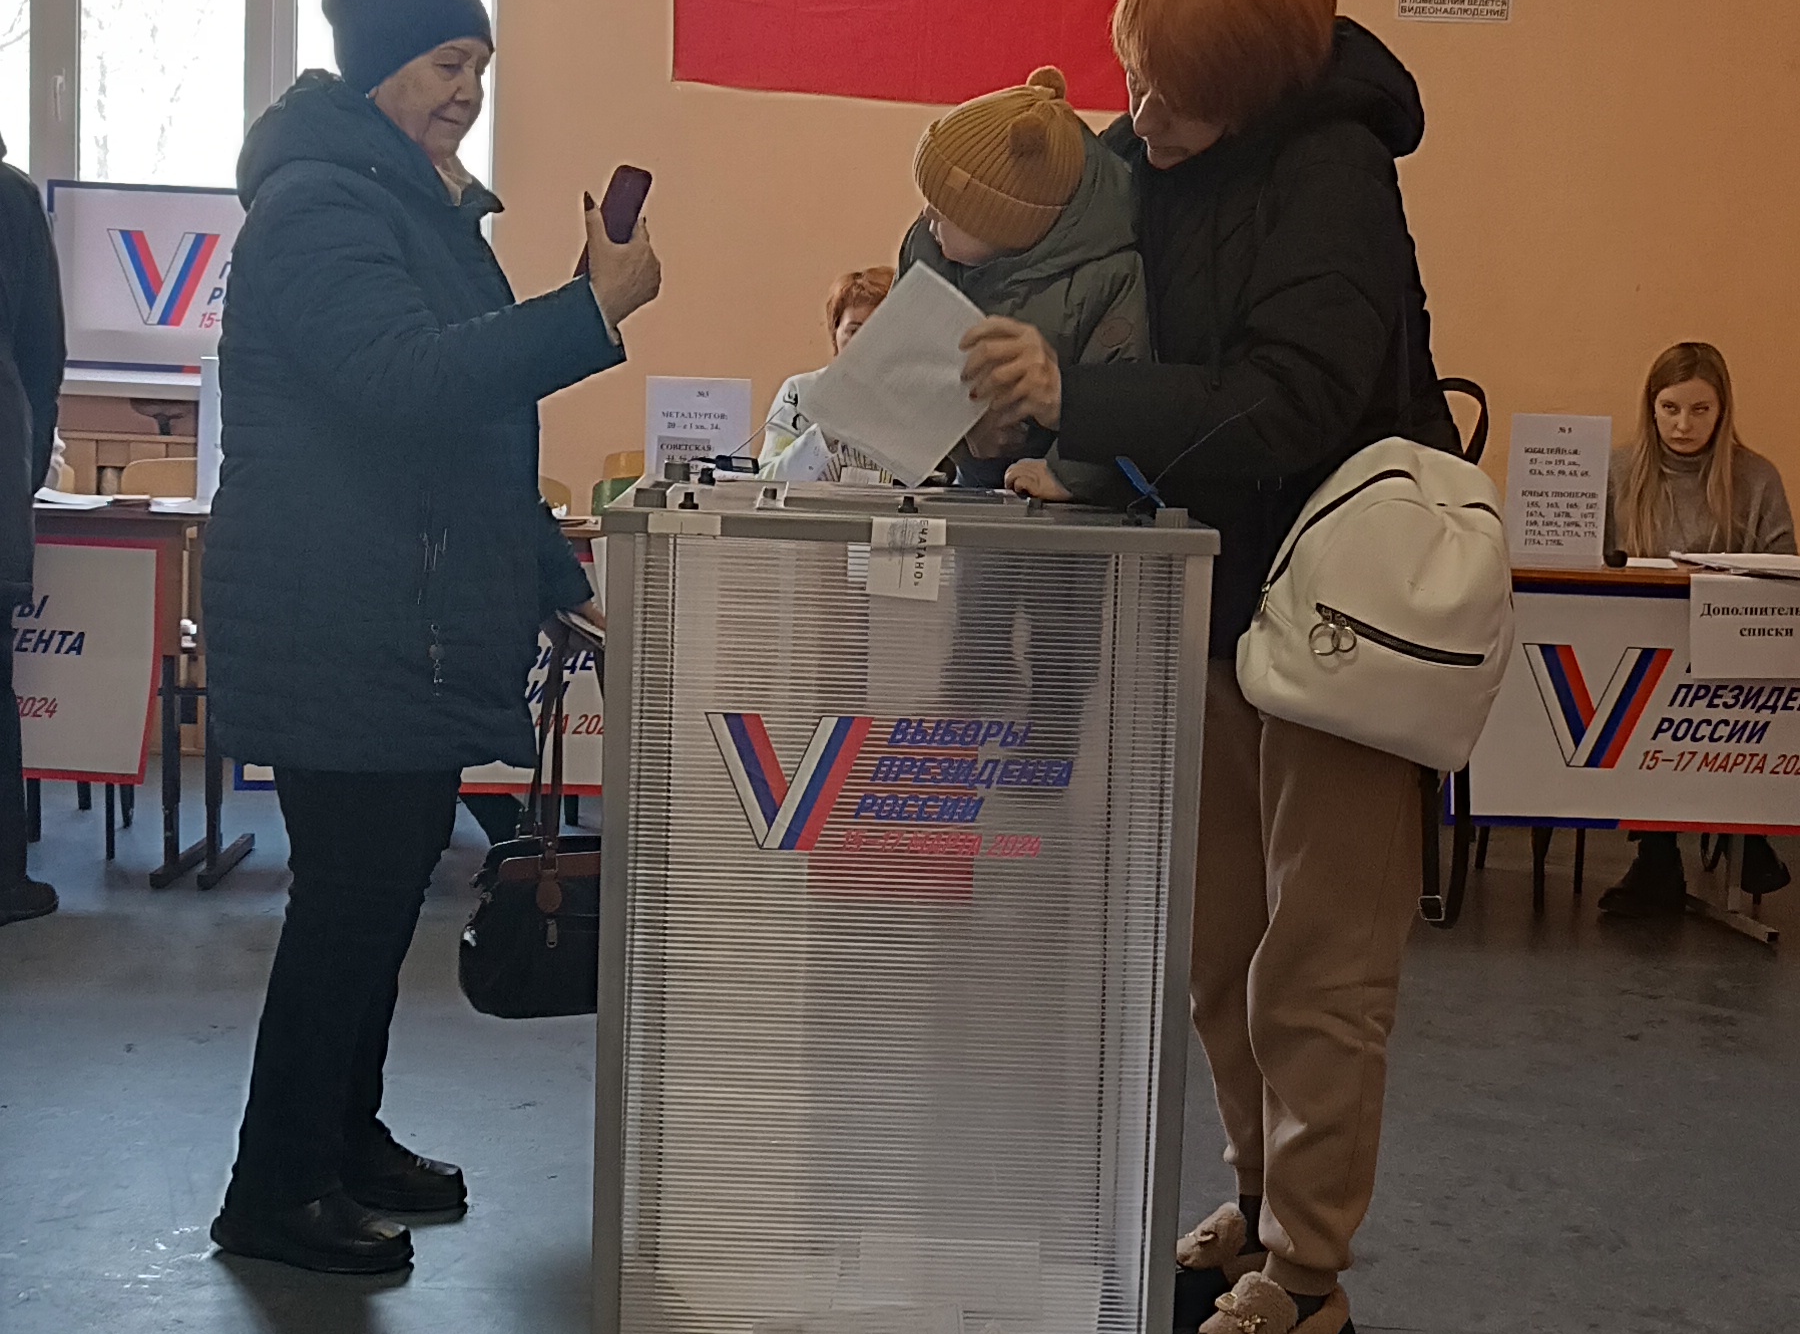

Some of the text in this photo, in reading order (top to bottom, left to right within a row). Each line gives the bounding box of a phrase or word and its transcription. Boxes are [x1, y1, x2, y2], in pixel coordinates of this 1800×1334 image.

[1400, 5, 1506, 17] ВИДЕОНАБЛЮДЕНИЕ
[13, 628, 85, 656] ЕНТА
[1739, 626, 1794, 637] списки
[1667, 683, 1800, 715] ПРЕЗИДЕ
[888, 718, 1034, 747] ВЫБОРЫ
[1651, 717, 1771, 744] РОССИИ
[869, 755, 1074, 789] ПРЕЗИДЕНТА
[1697, 751, 1768, 774] МАРТА
[854, 793, 986, 823] РОССИИ
[907, 831, 983, 856] МАРТА
[986, 834, 1041, 858] 2024
